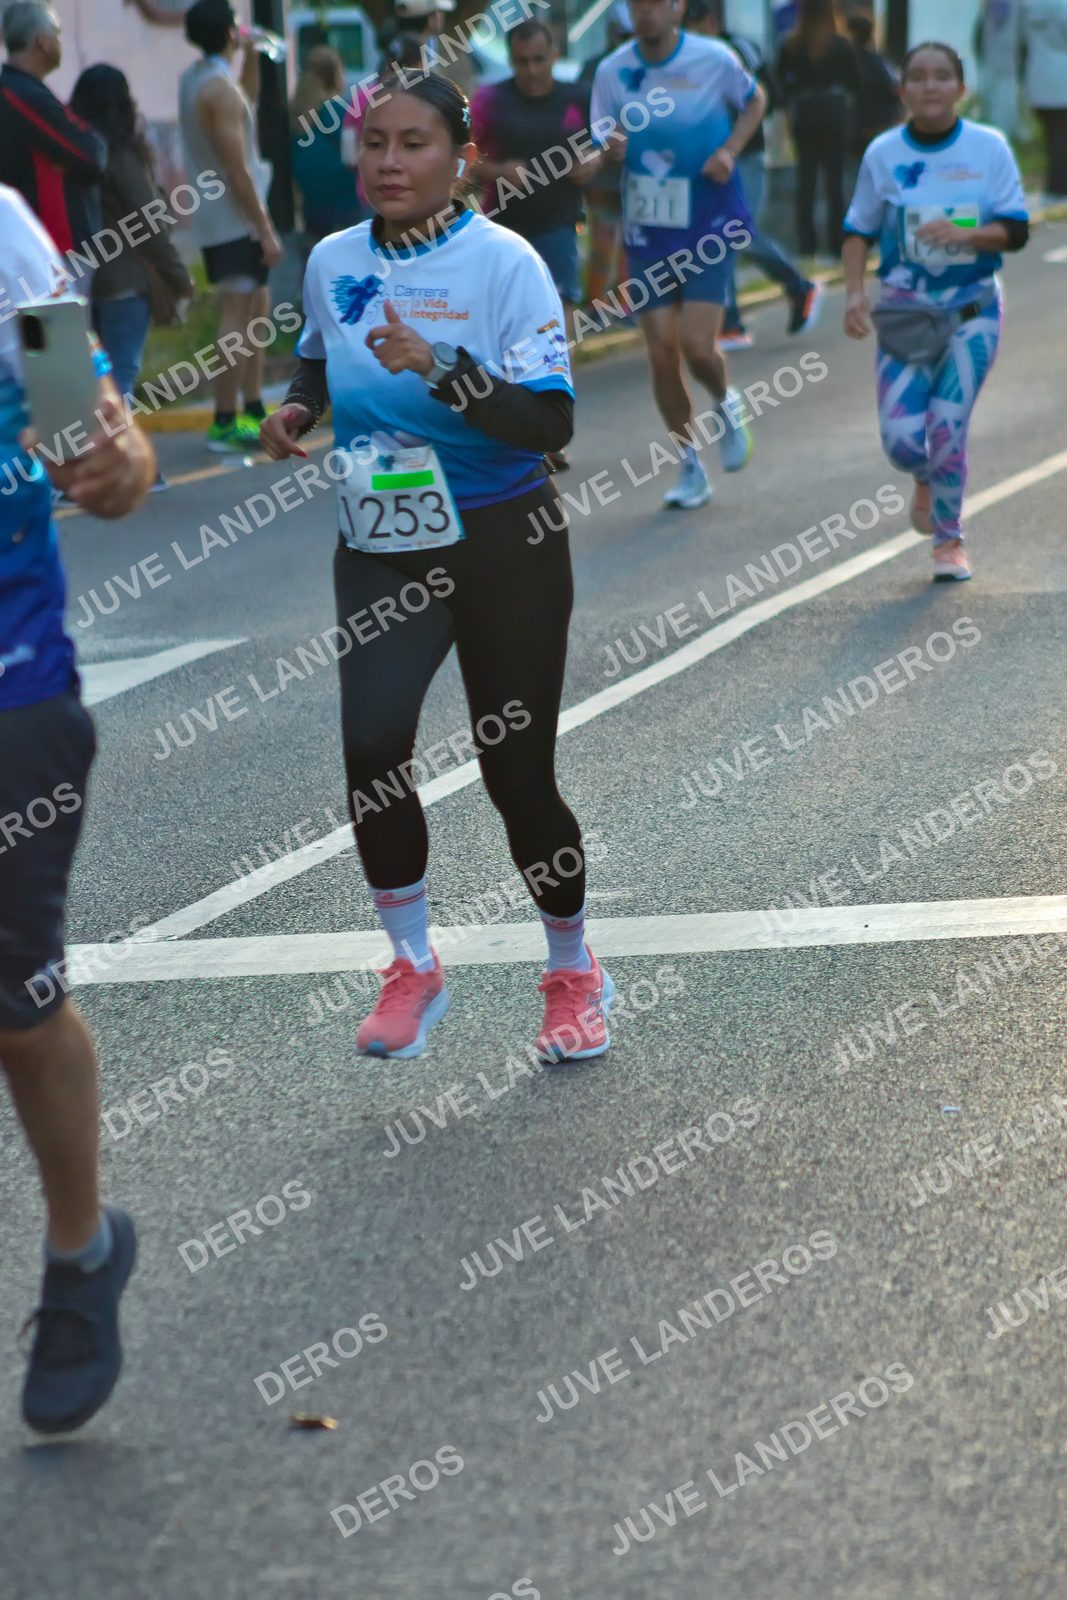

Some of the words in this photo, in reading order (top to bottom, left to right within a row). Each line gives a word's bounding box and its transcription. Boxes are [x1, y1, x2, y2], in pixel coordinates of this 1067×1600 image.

[634, 196, 675, 219] 211
[393, 284, 449, 298] Carrera
[423, 298, 448, 309] Vida
[410, 309, 469, 321] Integridad
[340, 491, 450, 539] 1253
